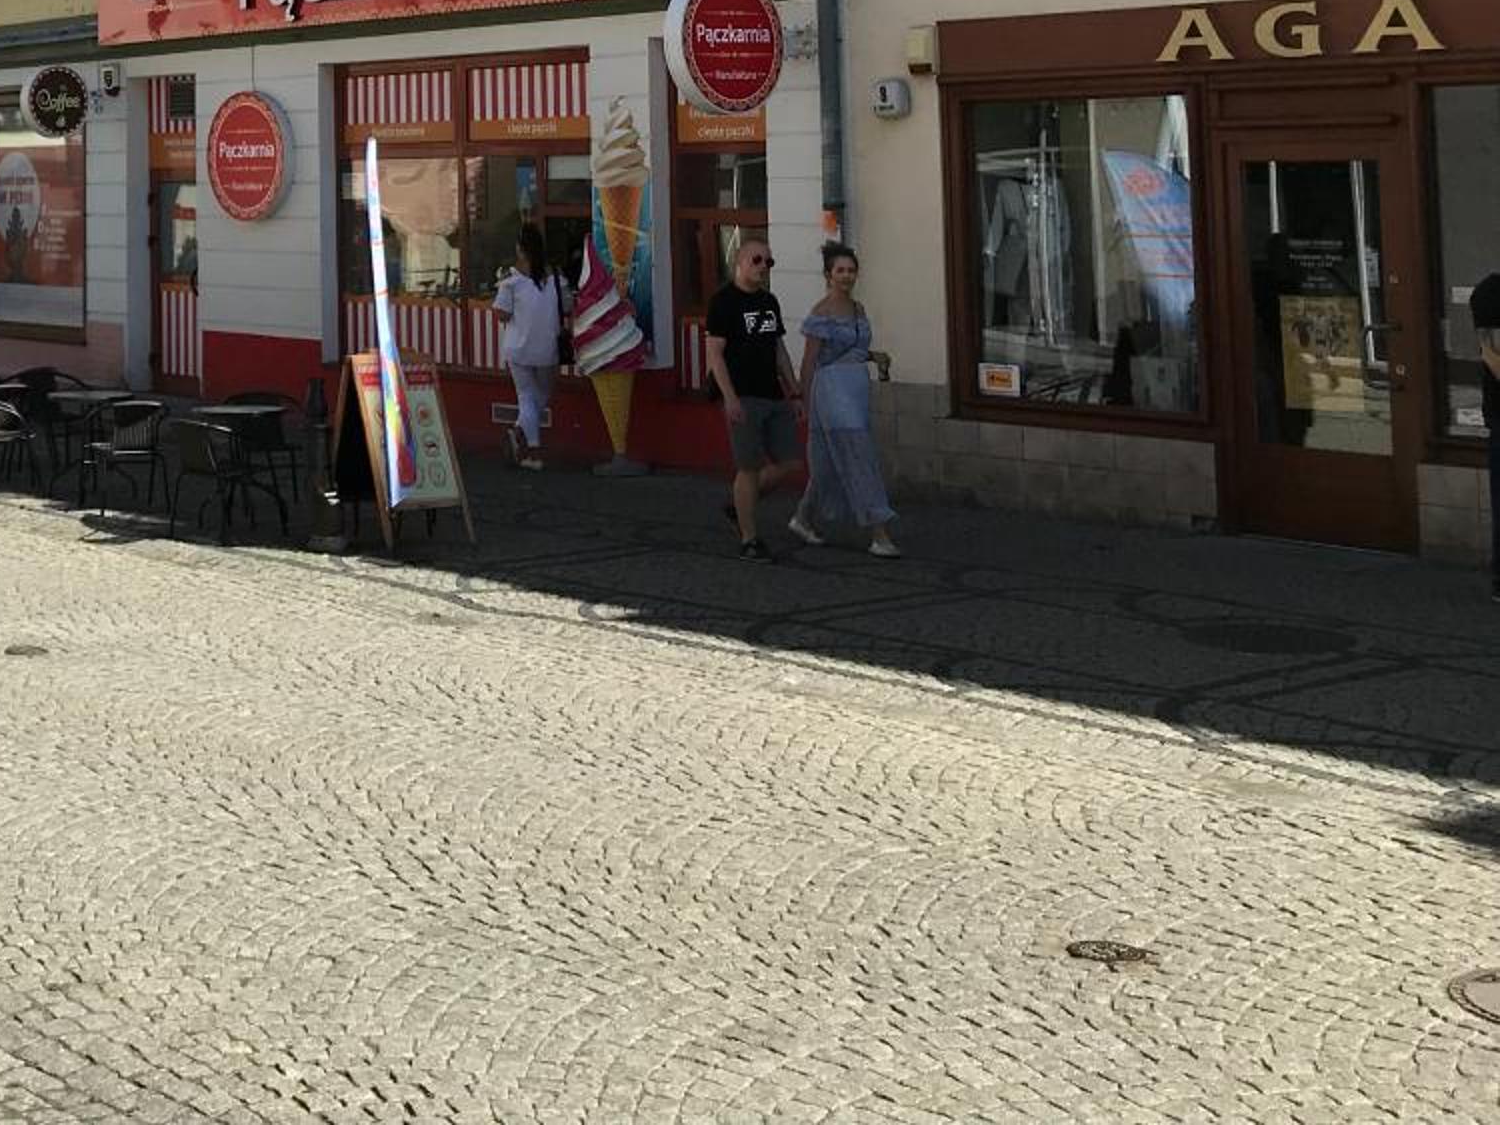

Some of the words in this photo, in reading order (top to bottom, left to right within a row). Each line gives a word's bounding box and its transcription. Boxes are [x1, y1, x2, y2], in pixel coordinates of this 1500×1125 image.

[695, 22, 771, 48] Pączkarnia
[36, 89, 80, 112] Coffee
[219, 140, 275, 163] Pączkarnia
